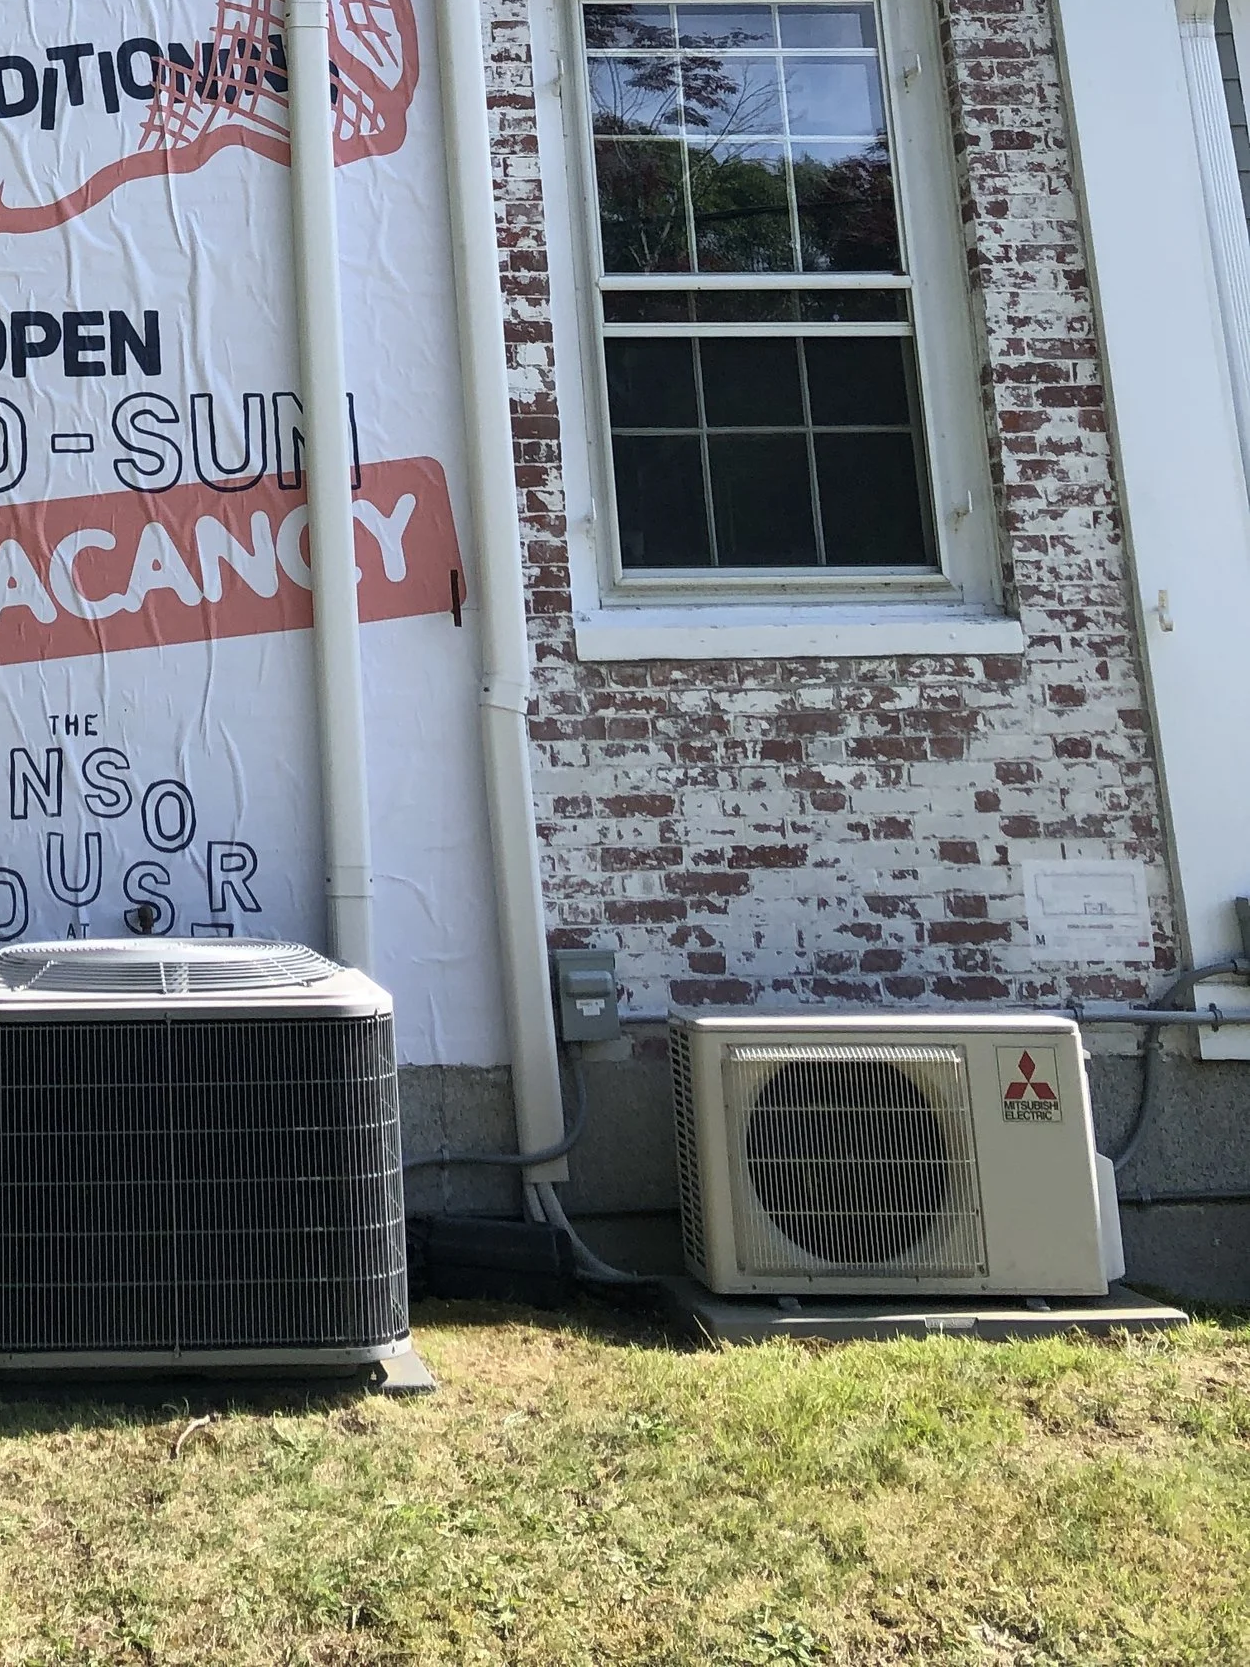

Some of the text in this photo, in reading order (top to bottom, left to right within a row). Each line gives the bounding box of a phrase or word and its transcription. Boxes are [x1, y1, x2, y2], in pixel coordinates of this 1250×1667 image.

[49, 713, 98, 736] THE
[1004, 1100, 1059, 1111] MITSUBISHI
[1005, 1110, 1053, 1121] ELECTRIC
